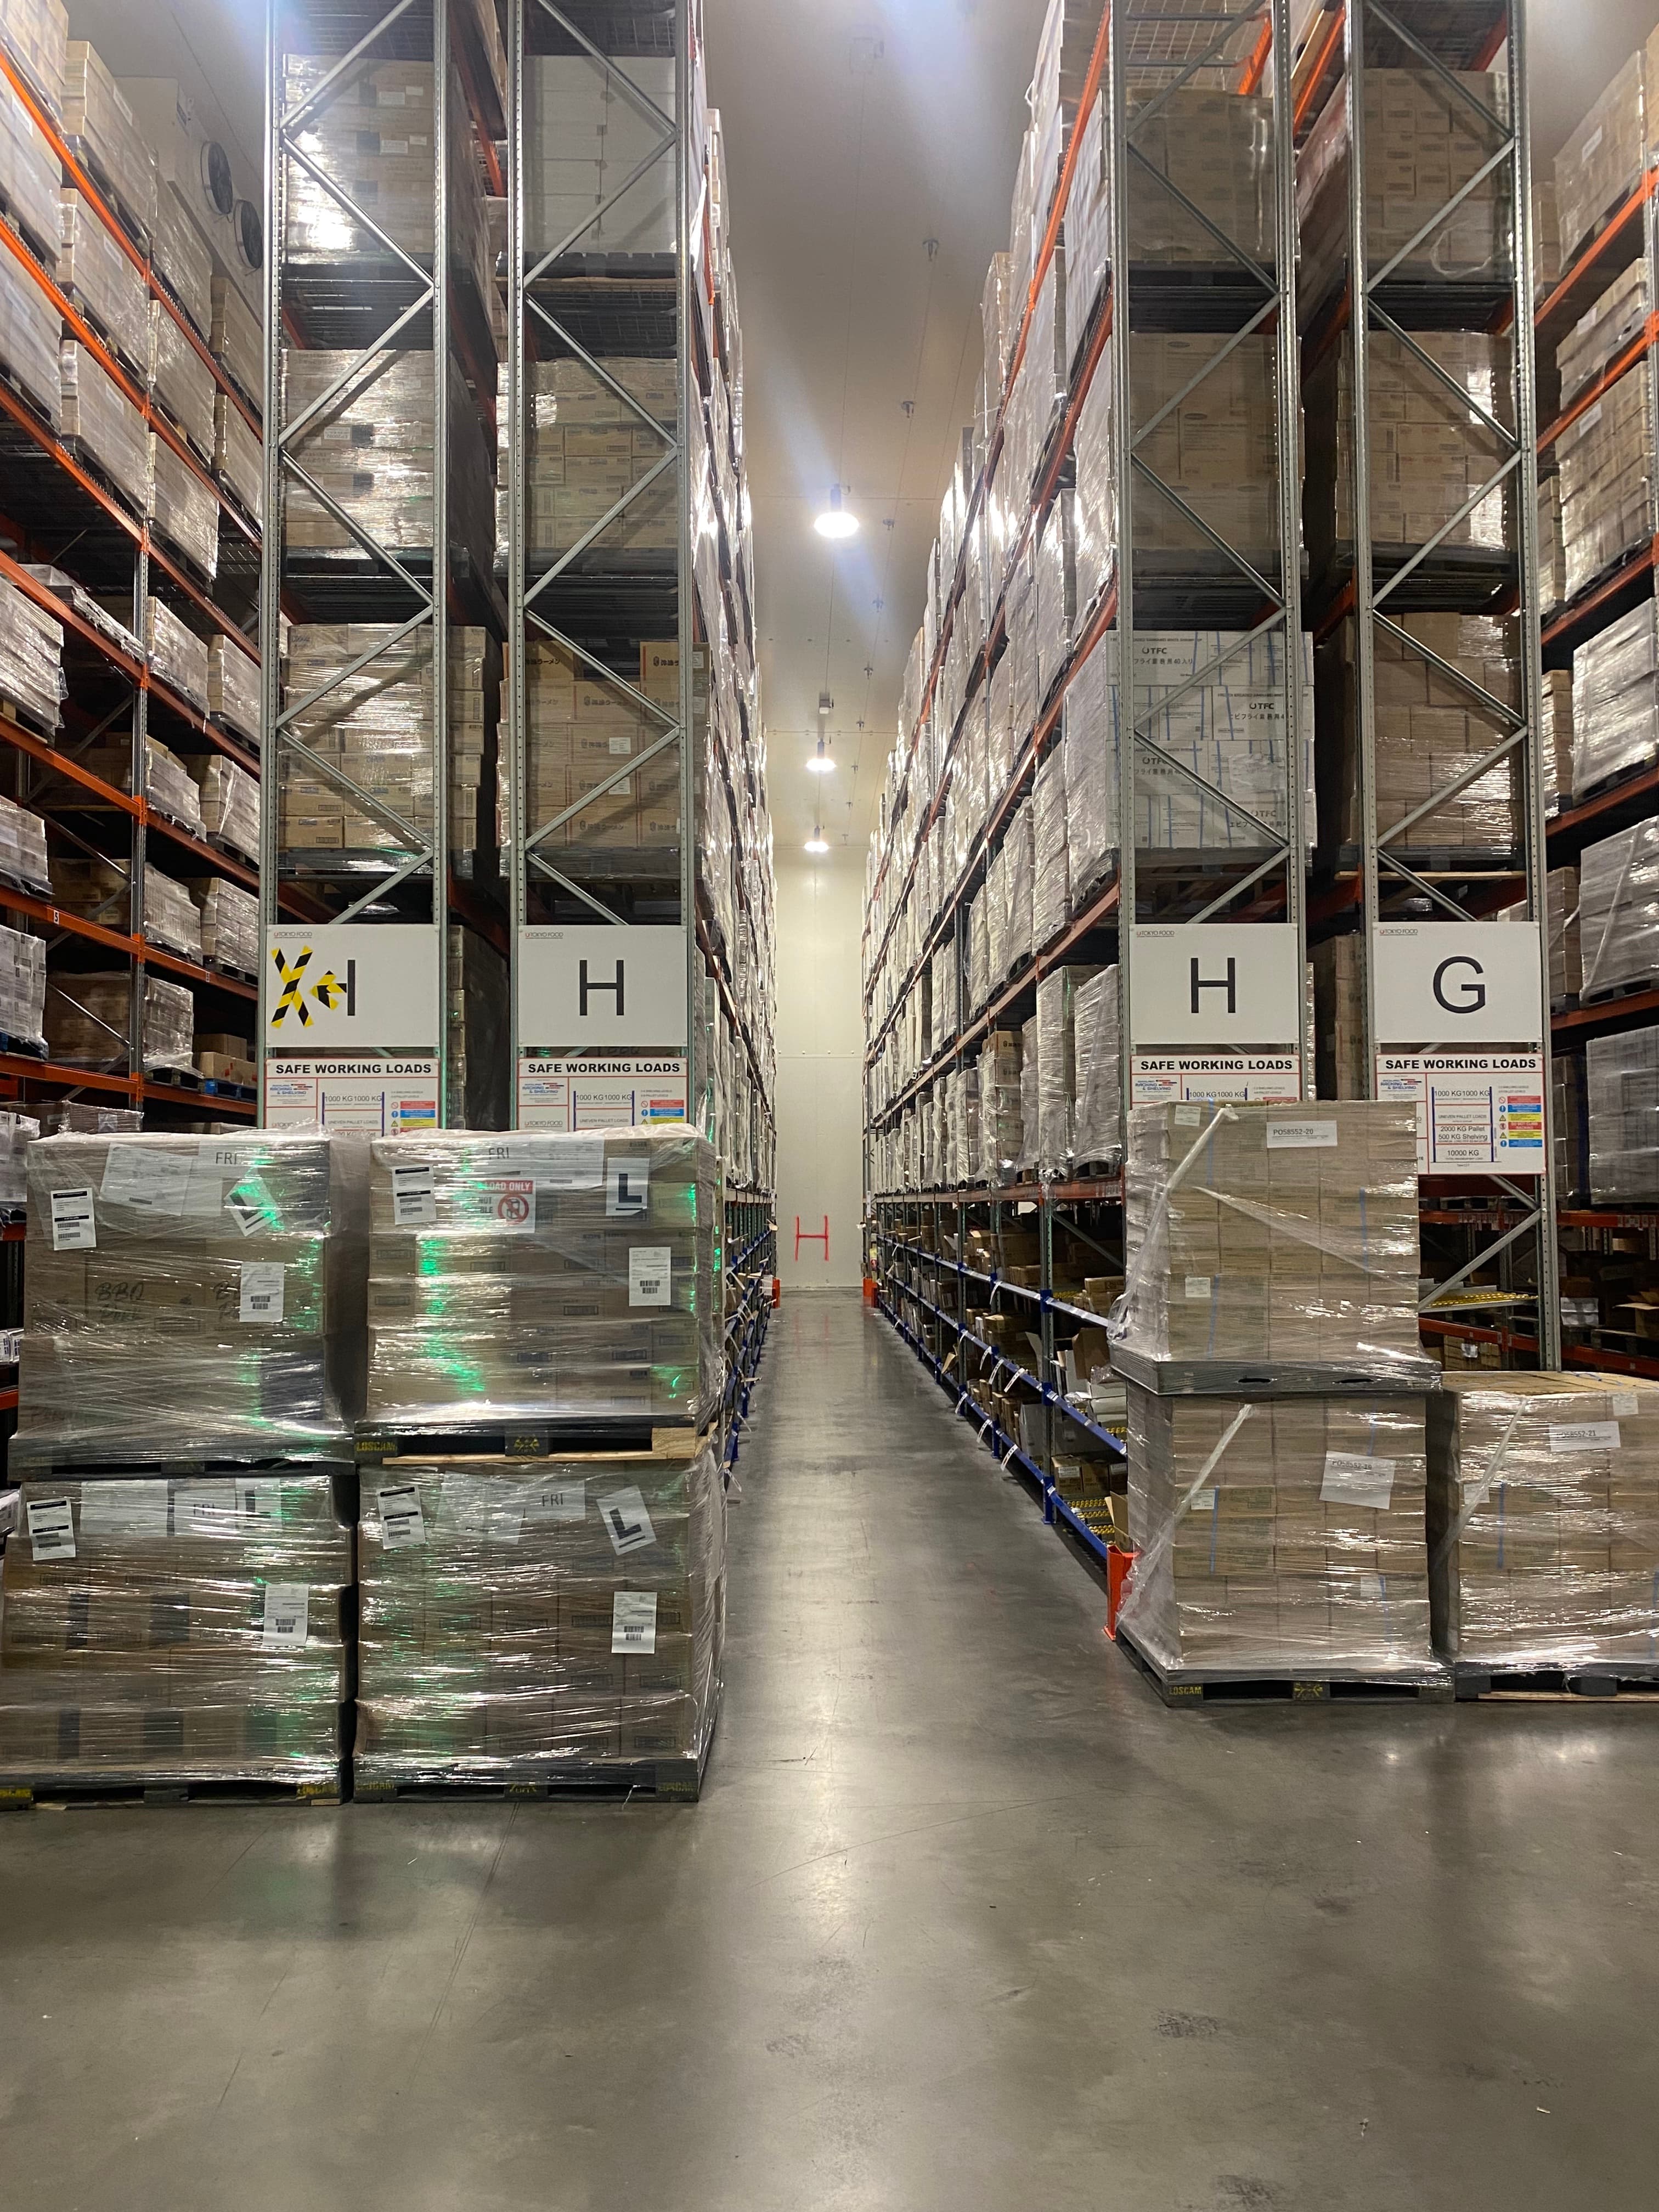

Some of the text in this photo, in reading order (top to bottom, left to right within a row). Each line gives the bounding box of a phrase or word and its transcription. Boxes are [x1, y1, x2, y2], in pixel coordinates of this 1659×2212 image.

[579, 960, 624, 1016] H
[1190, 957, 1235, 1014] H
[1432, 956, 1486, 1014] G
[276, 1064, 431, 1074] SAFE WORKING LOADS
[528, 1063, 680, 1073] SAFE WORKING LOADS
[1141, 1060, 1293, 1070] SAFE WORKING LOADS
[1386, 1059, 1536, 1069] SAFE WORKING LOADS
[216, 1152, 238, 1165] FRI
[489, 1147, 509, 1159] FRI
[509, 1182, 531, 1190] ONLY
[619, 1173, 642, 1203] L
[794, 1215, 829, 1261] H
[541, 1493, 563, 1506] FRI
[609, 1508, 642, 1539] L
[1169, 1686, 1202, 1695] LOSCAM
